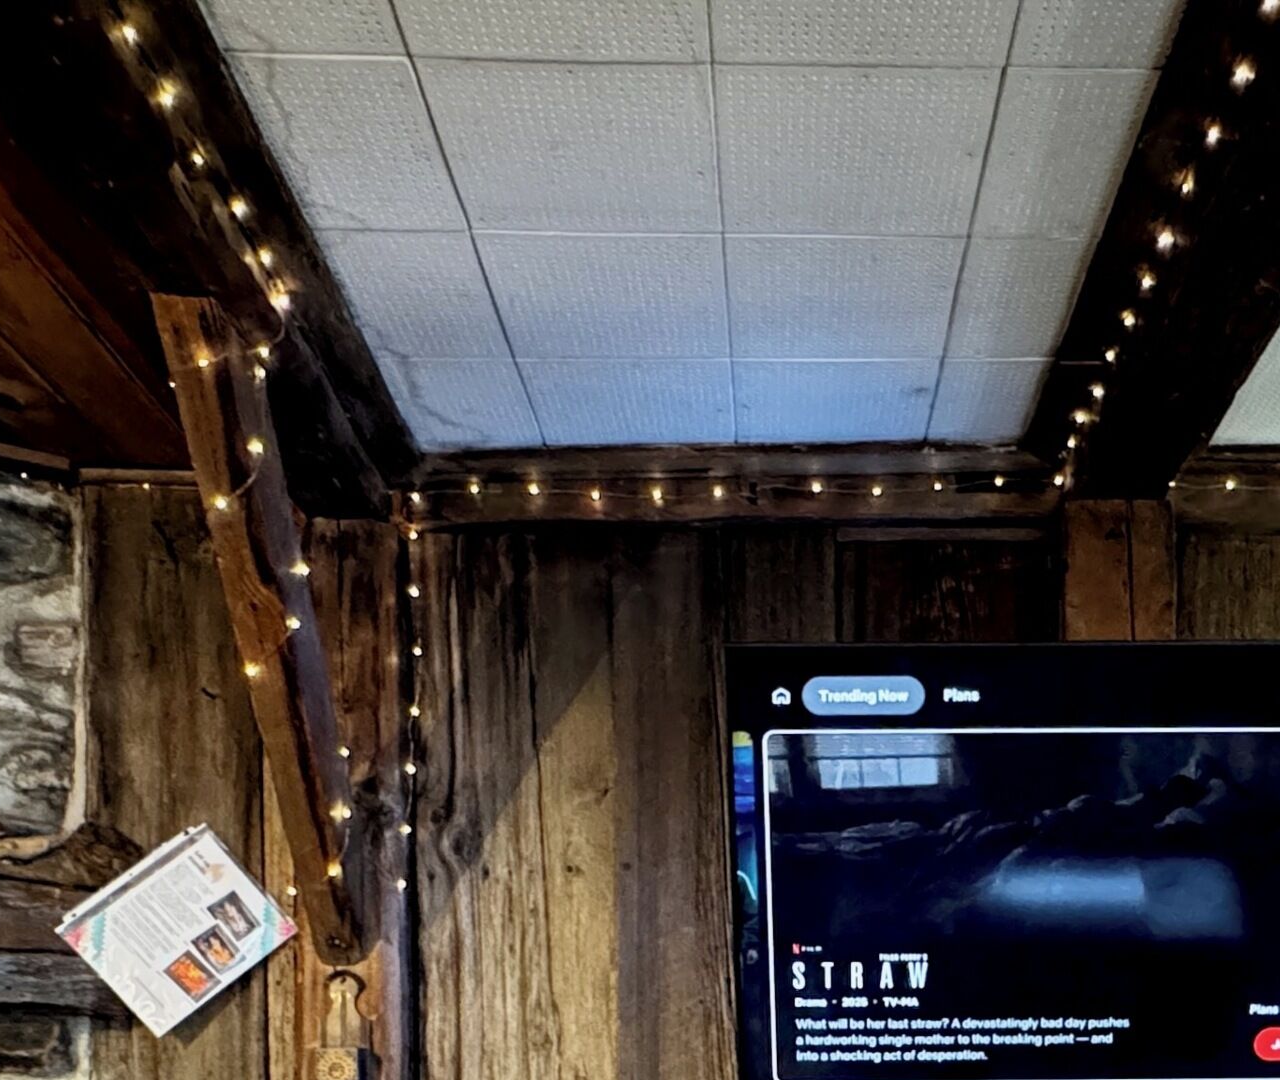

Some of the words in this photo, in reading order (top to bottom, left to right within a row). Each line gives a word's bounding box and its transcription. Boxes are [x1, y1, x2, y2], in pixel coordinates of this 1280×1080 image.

[818, 688, 877, 705] Trending
[878, 689, 909, 702] Now
[943, 688, 980, 702] Plans
[792, 961, 928, 990] STRAW
[1249, 1003, 1279, 1015] Plans
[795, 1018, 827, 1029] What
[828, 1018, 848, 1029] will
[849, 1018, 865, 1029] be
[866, 1018, 885, 1029] her
[887, 1018, 908, 1029] last
[910, 1018, 949, 1029] straw?
[951, 1018, 960, 1029] A
[962, 1017, 1039, 1031] devastatingly
[1040, 1017, 1063, 1028] bad
[1064, 1017, 1086, 1030] day
[1087, 1017, 1130, 1030] pushes
[795, 1036, 804, 1046] a
[805, 1034, 876, 1048] hardworking
[878, 1034, 912, 1047] single
[914, 1034, 955, 1045] mother
[957, 1034, 971, 1044] to
[971, 1033, 990, 1044] the
[992, 1033, 1042, 1047] breaking
[1044, 1033, 1074, 1046] point
[1091, 1032, 1113, 1044] and
[820, 1052, 828, 1061] a
[830, 1050, 881, 1063] shocking
[883, 1050, 901, 1060] act
[903, 1050, 916, 1060] of
[917, 1050, 988, 1062] desperation.
